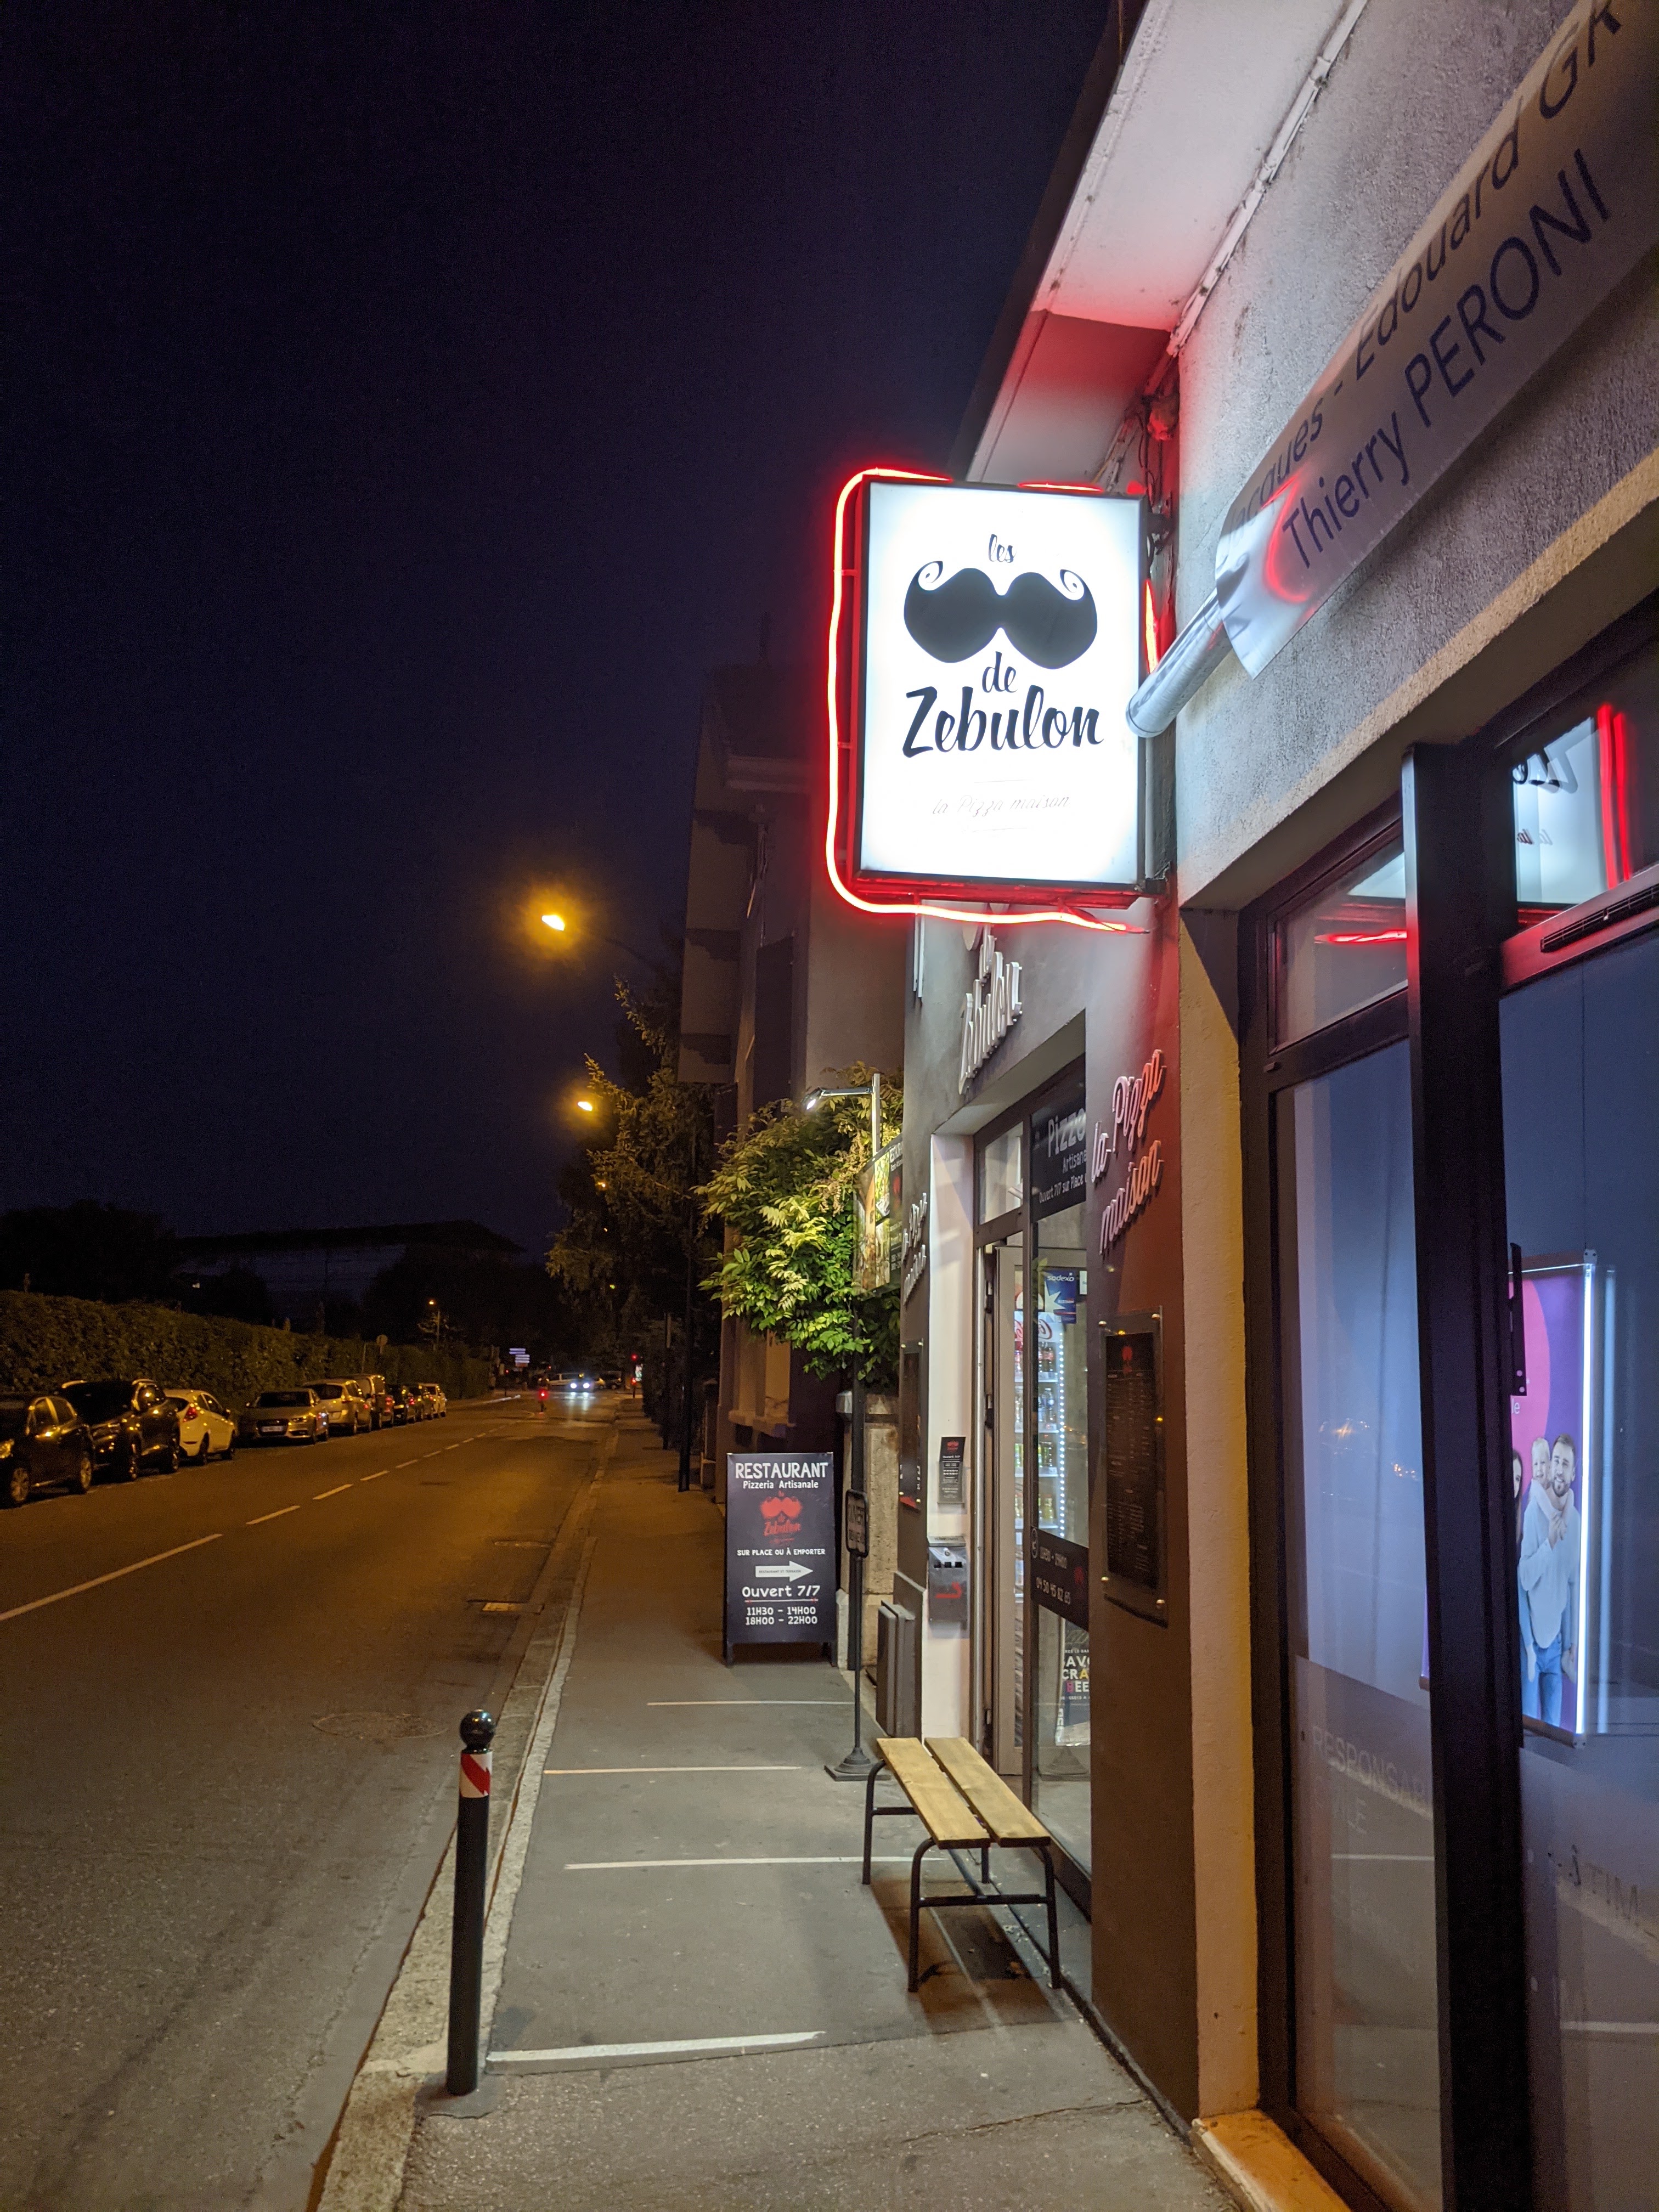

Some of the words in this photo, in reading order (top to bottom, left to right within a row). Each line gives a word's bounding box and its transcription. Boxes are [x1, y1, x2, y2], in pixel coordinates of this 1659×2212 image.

[1354, 94, 1523, 380] Edouard
[1282, 410, 1409, 569] Thierry
[1403, 148, 1611, 427] PERONI
[988, 534, 1015, 563] les
[982, 651, 1018, 693] de
[902, 685, 1104, 758] Zebulon
[932, 799, 949, 815] la
[957, 795, 1002, 817] Pizza
[1010, 795, 1070, 810] maison
[1092, 1121, 1111, 1183] la
[1112, 1049, 1167, 1153] Pizza
[1070, 1174, 1084, 1189] Place
[1099, 1140, 1164, 1255] maison
[1047, 1273, 1075, 1282] sodexo
[735, 1462, 828, 1479] RESTAURANT
[743, 1480, 774, 1488] Pizzeria
[779, 1480, 819, 1488] Artisanale
[786, 1547, 791, 1555] À
[742, 1585, 792, 1597] Ouvert
[797, 1585, 821, 1596] 7/7
[747, 1607, 774, 1616] 11H30
[787, 1606, 816, 1615] 14H00
[745, 1617, 775, 1626] 18H00
[788, 1616, 818, 1624] 22H00
